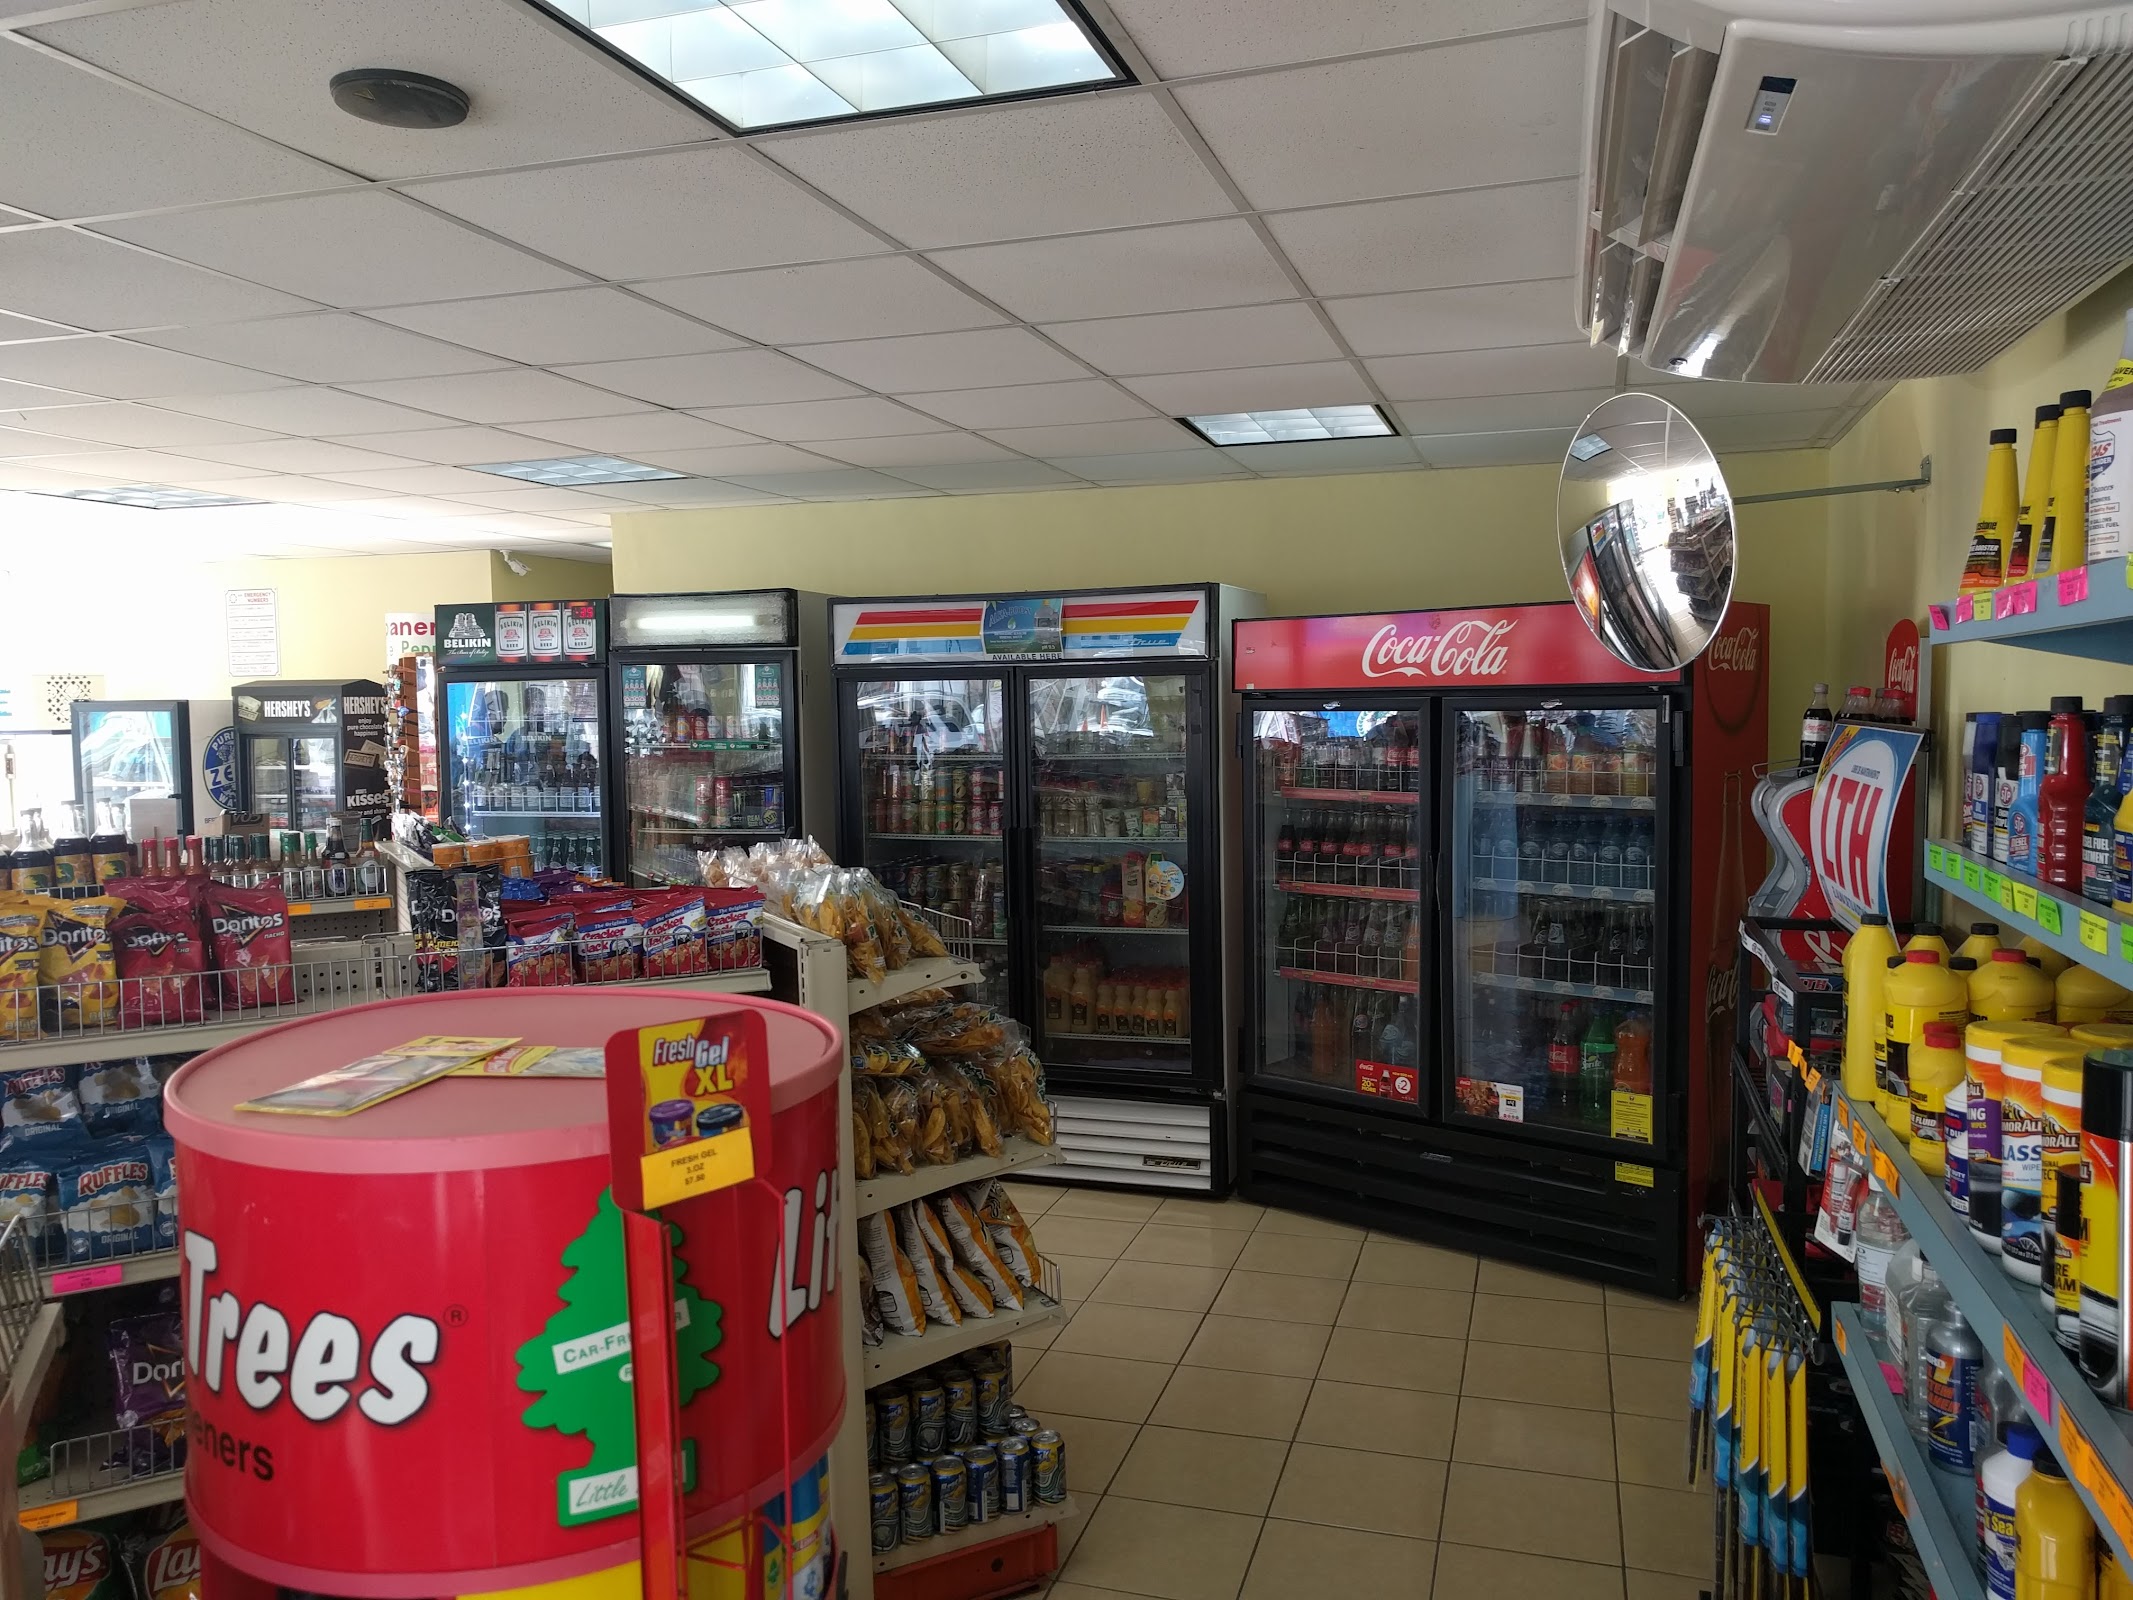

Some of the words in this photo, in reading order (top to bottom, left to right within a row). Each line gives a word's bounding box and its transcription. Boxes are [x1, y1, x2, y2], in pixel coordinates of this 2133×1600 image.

[386, 620, 436, 636] aner
[443, 637, 492, 648] BELIKIN
[1361, 617, 1520, 679] Coca-Cola
[1706, 626, 1761, 673] Coca-Cola
[992, 653, 1037, 661] AVAILABLE
[1039, 652, 1062, 660] HERE
[1887, 645, 1916, 693] Coca-Cola
[264, 700, 311, 718] HERSHEY'S
[343, 696, 387, 715] HERSHEY'S
[358, 717, 372, 725] enjoy
[2000, 785, 2012, 804] STP
[2014, 815, 2026, 834] STP
[1820, 773, 1884, 910] LTH
[2093, 837, 2109, 851] FUEL
[665, 907, 686, 918] Original
[728, 903, 749, 913] Original
[212, 912, 284, 934] Doritos
[604, 918, 628, 928] Original
[645, 916, 685, 936] Cracker
[707, 910, 749, 927] Cracker
[582, 927, 626, 941] Cracker
[581, 940, 609, 954] Jack
[652, 1033, 696, 1067] Fresh
[695, 1035, 730, 1069] Gel
[694, 1065, 735, 1098] XL
[24, 1124, 62, 1137] ORIGINAL
[1915, 1116, 1936, 1128] FLUID
[670, 1152, 700, 1168] FRESH
[700, 1148, 718, 1159] GEL
[77, 1161, 149, 1197] RUFFLES
[101, 1231, 139, 1245] ORIGINAL
[183, 1229, 441, 1425] Trees
[575, 1472, 629, 1509] Little
